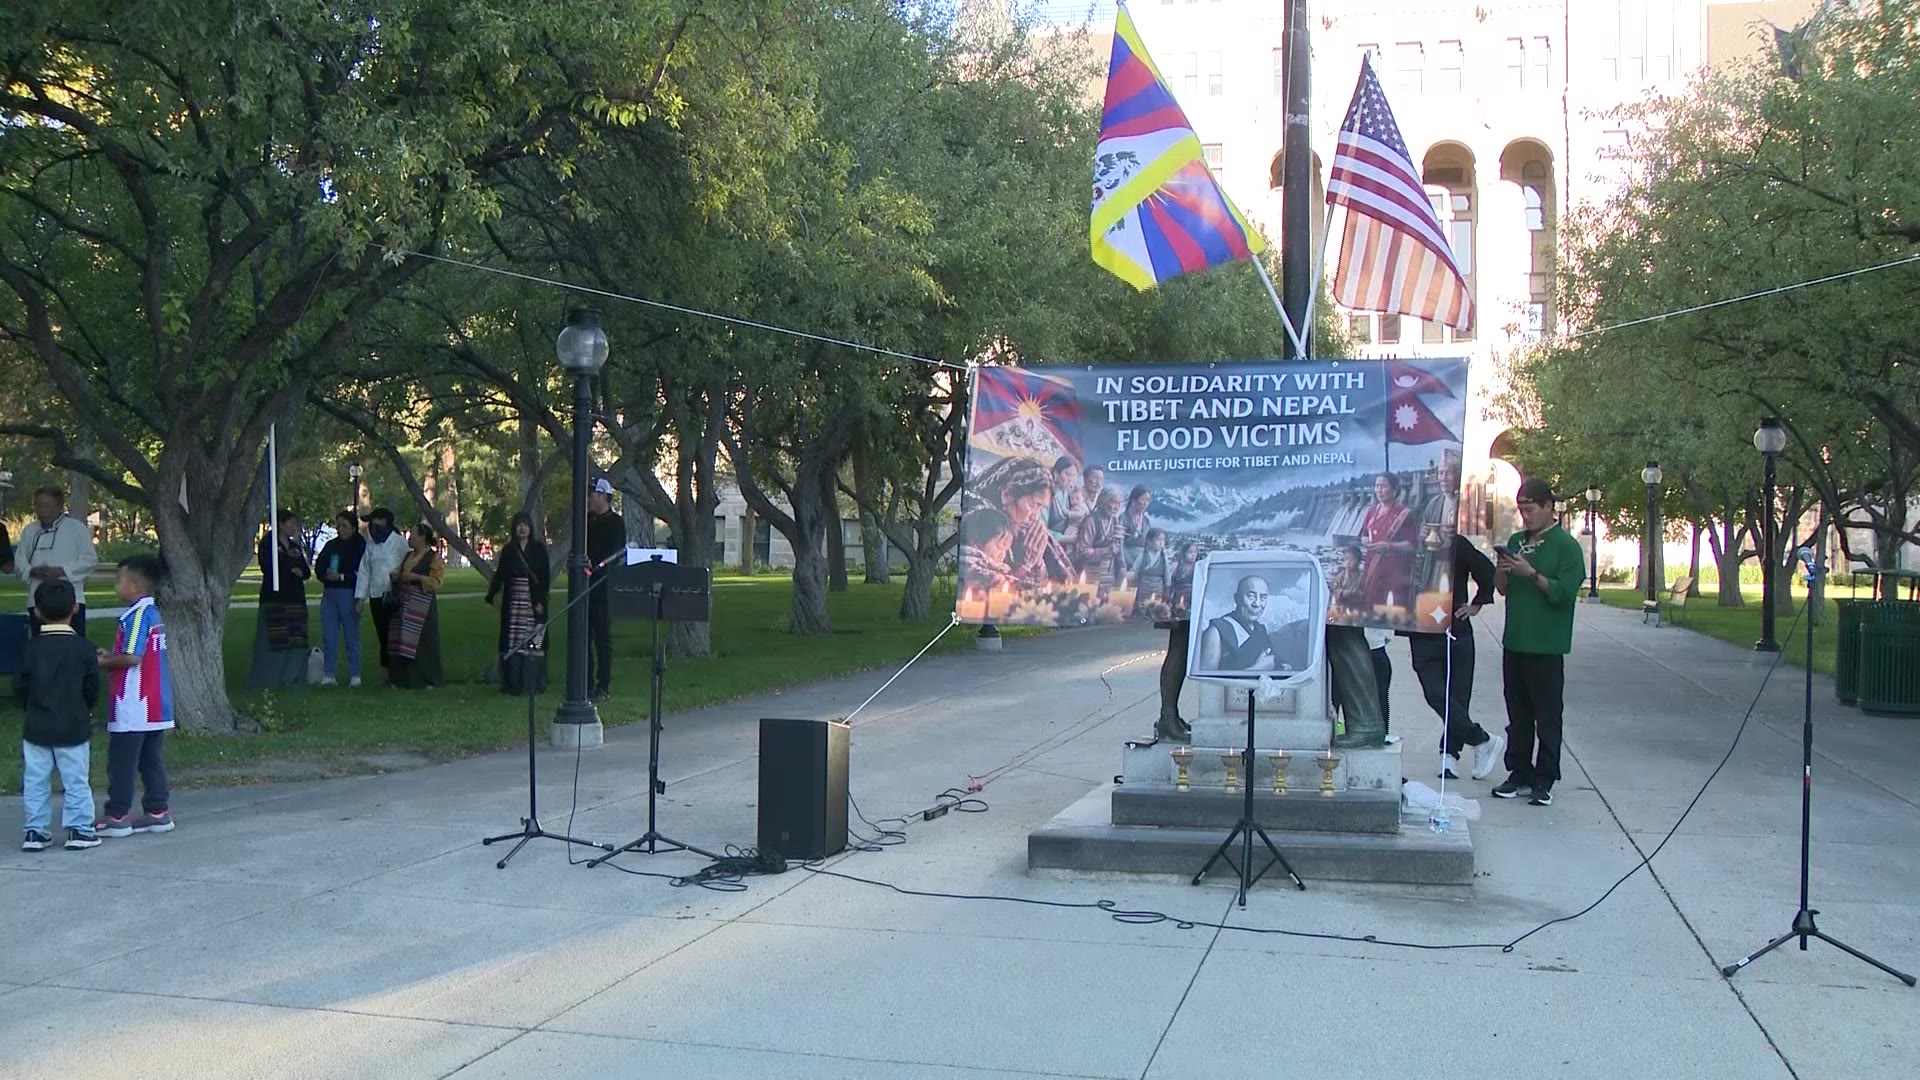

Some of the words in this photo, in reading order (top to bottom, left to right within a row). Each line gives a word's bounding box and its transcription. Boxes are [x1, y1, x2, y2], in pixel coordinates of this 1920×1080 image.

[1096, 377, 1123, 394] IN
[1131, 374, 1287, 394] SOLIDARITY
[1293, 372, 1364, 391] WITH
[1102, 399, 1184, 423] TIBET
[1189, 397, 1254, 419] AND
[1262, 394, 1356, 417] NEPAL
[1117, 427, 1213, 451] FLOOD
[1219, 421, 1341, 448] VICTIMS
[1108, 459, 1162, 471] CLIMATE
[1163, 458, 1212, 471] JUSTICE
[1215, 457, 1241, 469] FOR
[1243, 455, 1280, 468] TIBET
[1281, 454, 1311, 467] AND
[1313, 452, 1354, 464] NEPAL
